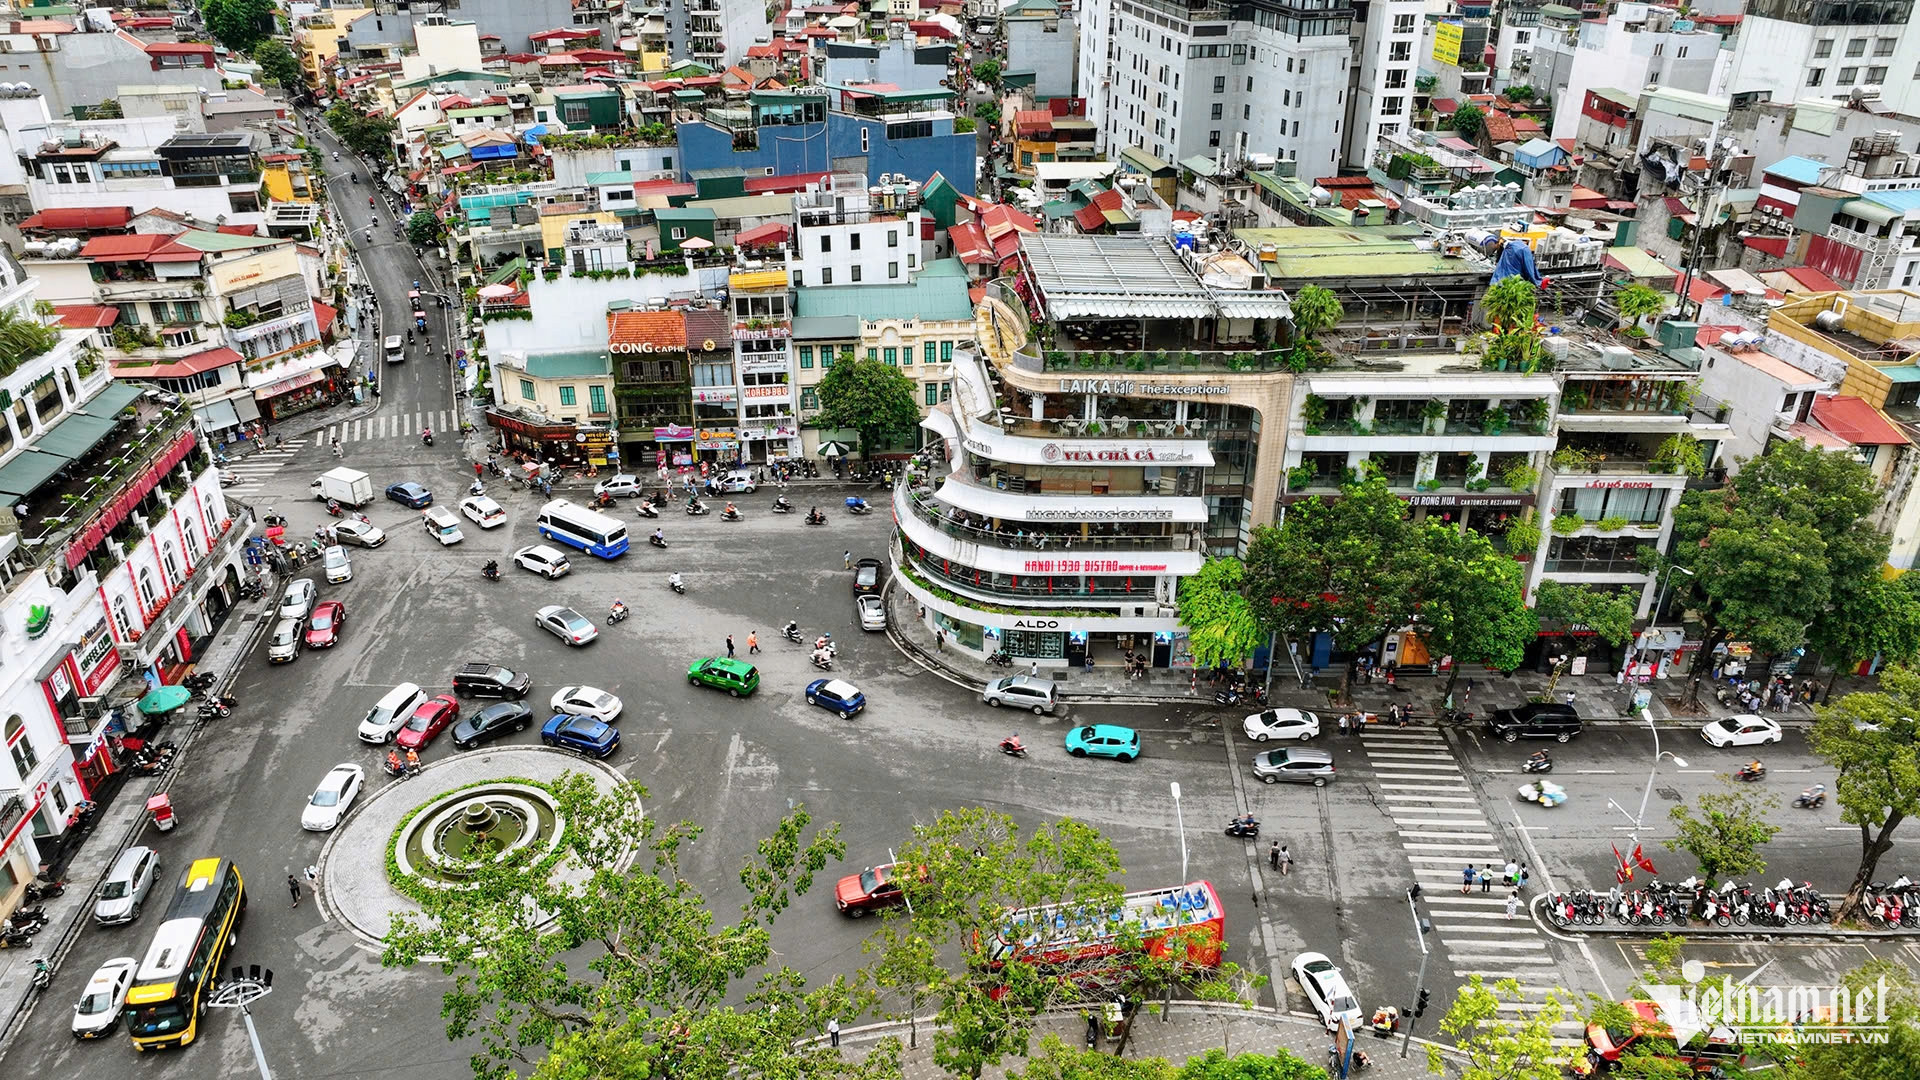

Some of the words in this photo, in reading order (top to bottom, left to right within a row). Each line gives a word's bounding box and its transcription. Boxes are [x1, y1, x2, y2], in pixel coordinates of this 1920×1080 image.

[257, 320, 294, 335] HERBALIST
[732, 328, 769, 340] Minsu
[1060, 379, 1112, 394] LAIKA
[1139, 384, 1162, 395] The
[1163, 384, 1231, 395] Exceptional
[1064, 450, 1094, 462] VUA
[1410, 496, 1420, 506] FU
[1420, 496, 1440, 505] RONG
[1440, 496, 1456, 506] HUA
[1026, 510, 1114, 520] HIGHLANDS
[1117, 510, 1173, 520] COFFEE
[1025, 560, 1054, 572] HANOI
[1057, 560, 1081, 572] 1930
[1084, 560, 1118, 572] BISTRO
[1014, 620, 1059, 629] ALDO
[84, 734, 103, 762] KFC
